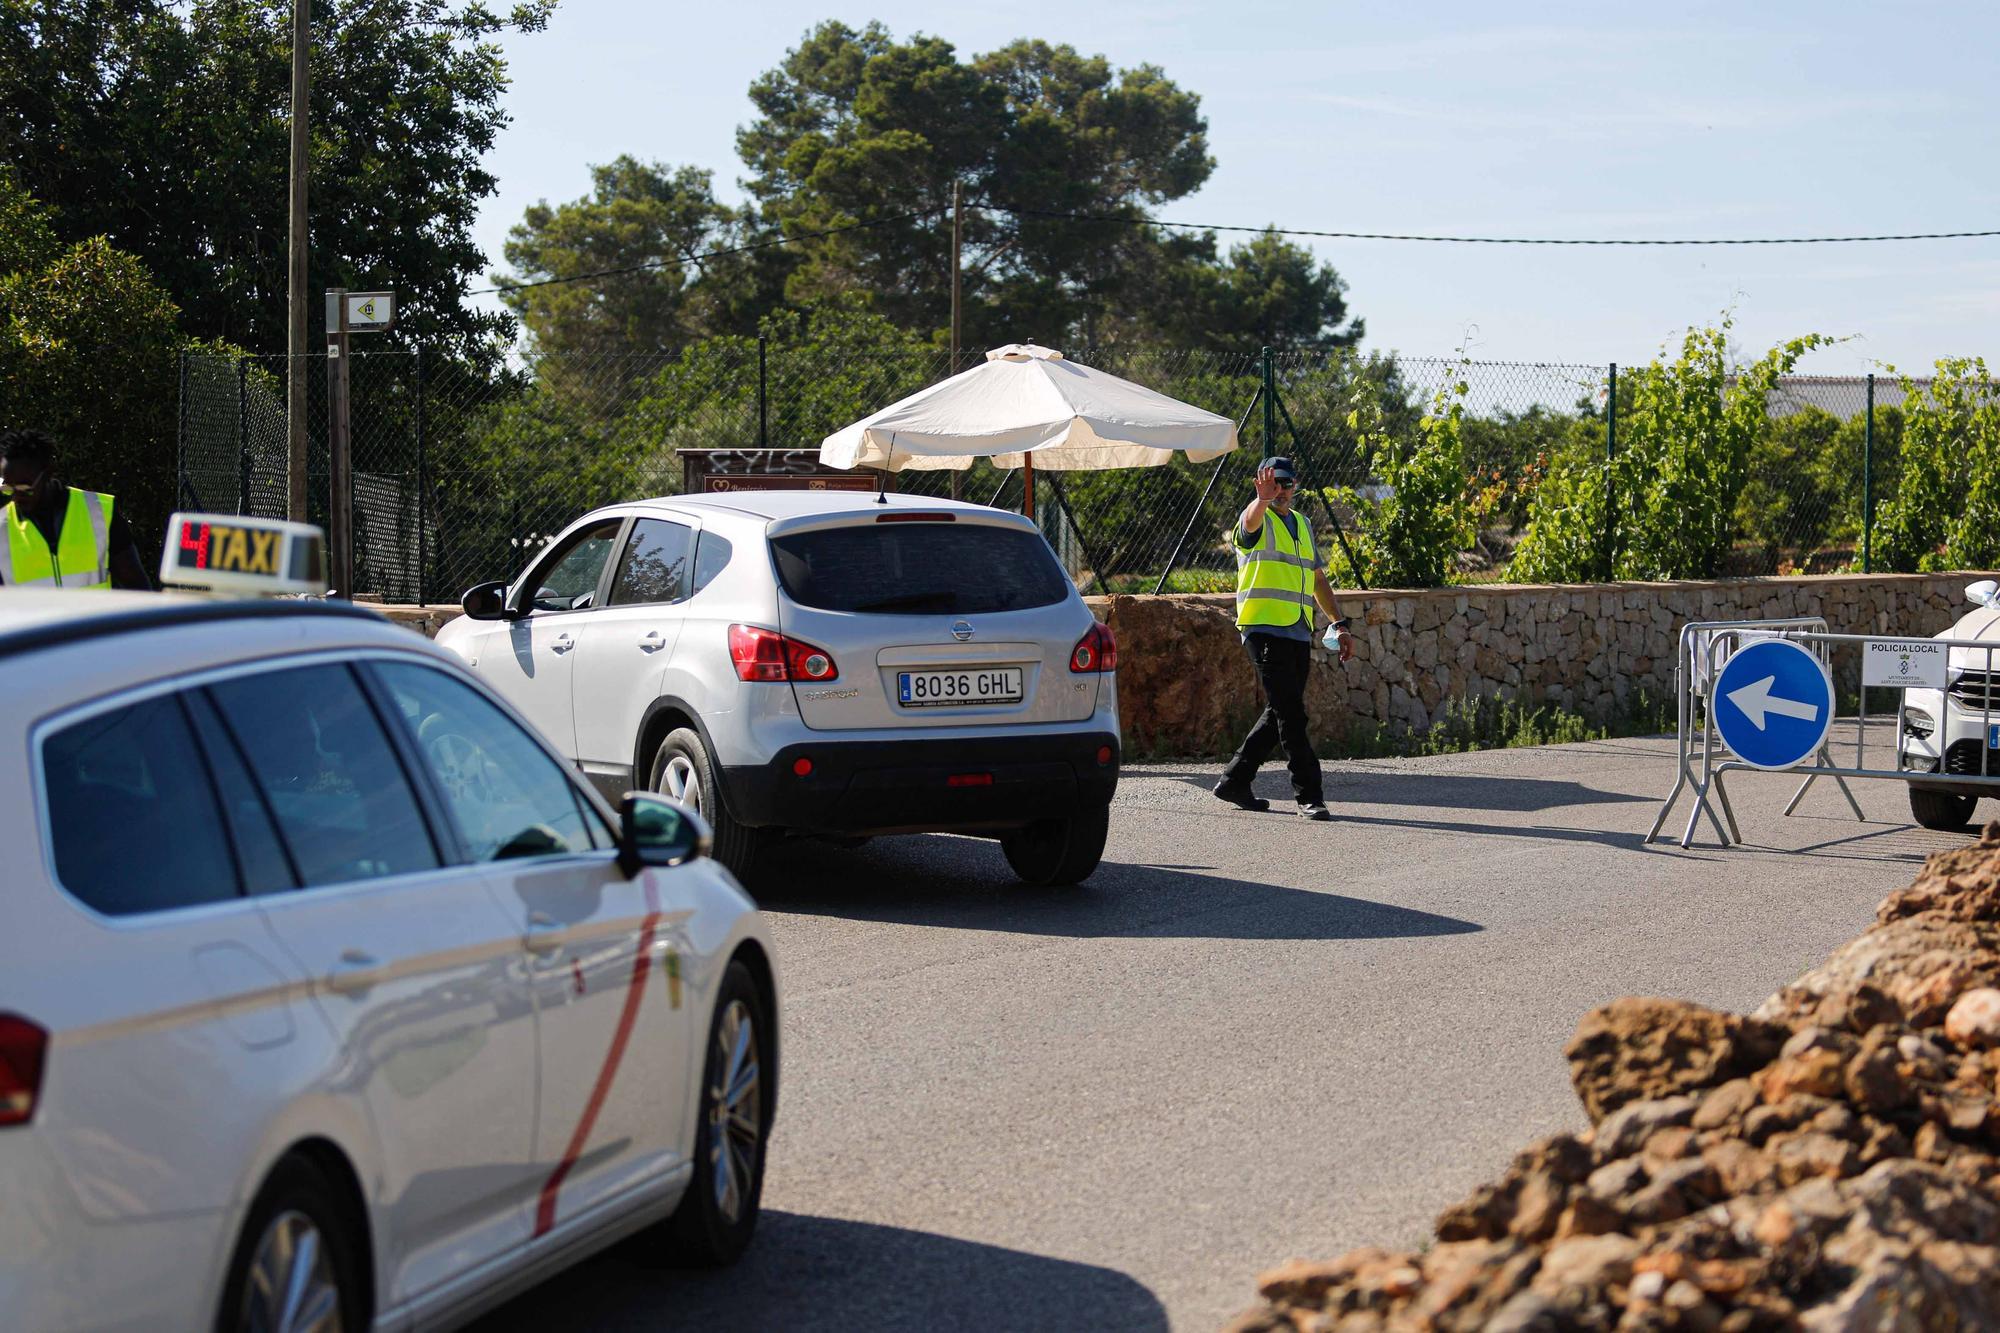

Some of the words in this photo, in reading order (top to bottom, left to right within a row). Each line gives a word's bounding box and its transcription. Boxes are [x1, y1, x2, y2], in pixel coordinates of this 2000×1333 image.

[180, 519, 211, 569] 4
[211, 526, 283, 575] TAXI
[1871, 643, 1908, 653] POLICIA
[1909, 644, 1939, 654] LOCAL
[903, 689, 909, 697] E
[915, 675, 970, 698] 8036
[978, 673, 1017, 695] GHL
